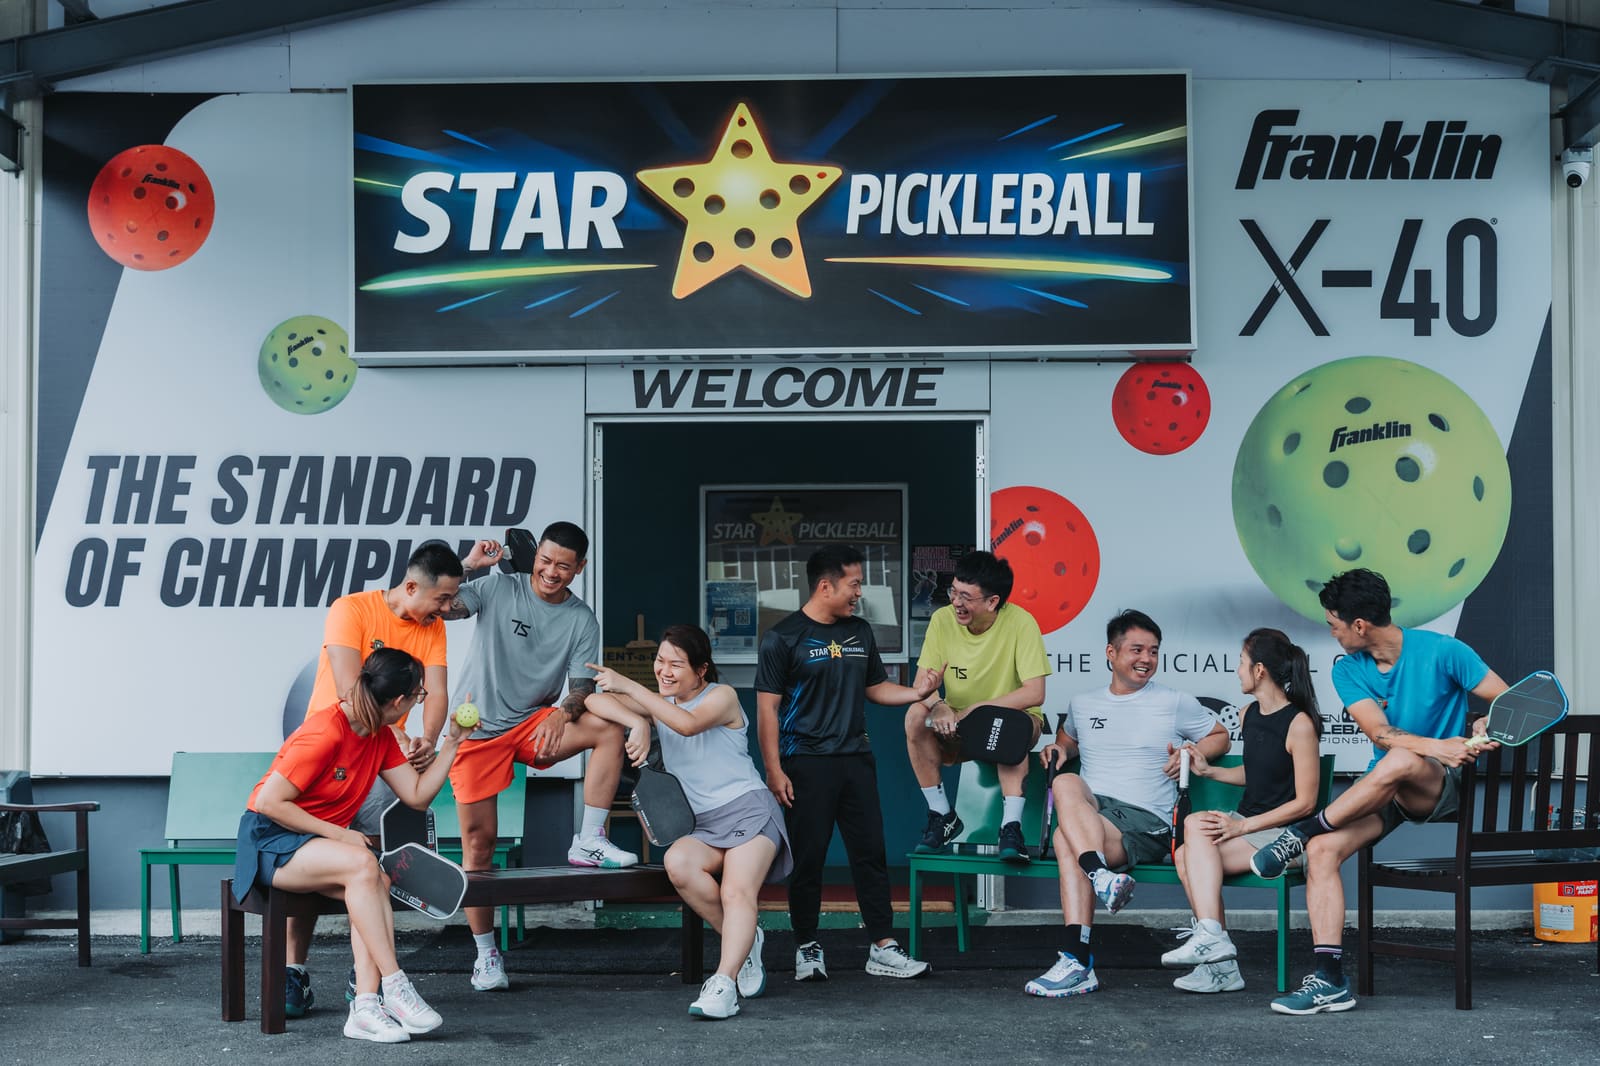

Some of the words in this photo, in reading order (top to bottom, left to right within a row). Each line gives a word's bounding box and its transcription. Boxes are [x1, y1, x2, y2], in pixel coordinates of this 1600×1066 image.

[393, 170, 628, 254] STAR
[846, 172, 1154, 237] PICKLEBALL
[632, 366, 945, 409] WELCOME
[85, 454, 197, 525] THE
[210, 454, 537, 527] STANDARD
[712, 522, 756, 540] STAR
[798, 521, 898, 539] PICKLEBALL
[64, 537, 147, 608] OF
[159, 537, 517, 608] CHAMPI
[809, 647, 829, 658] STAR
